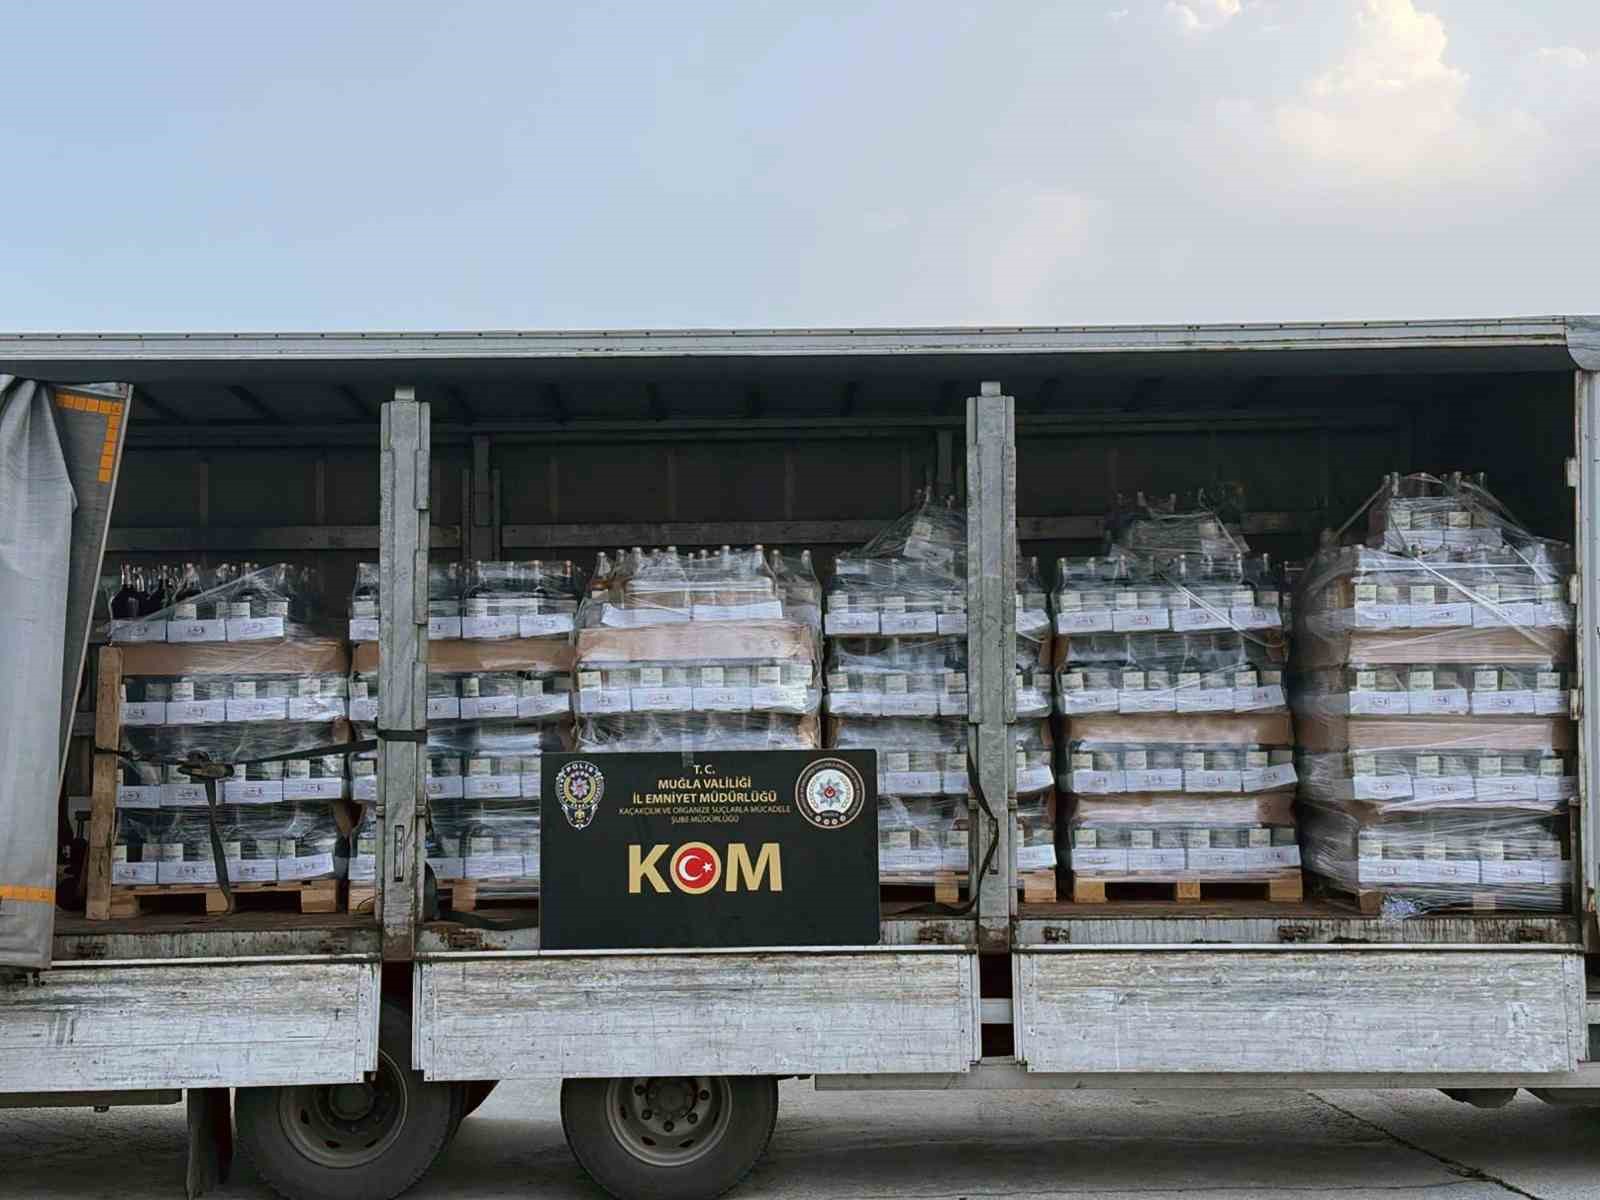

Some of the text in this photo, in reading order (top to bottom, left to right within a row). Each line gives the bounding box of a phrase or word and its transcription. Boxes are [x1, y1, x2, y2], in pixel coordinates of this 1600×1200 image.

[658, 775, 752, 789] MUĞLA VALİLİĞİ
[633, 790, 777, 804] İL EMNİYET MÜDÜRLÜĞÜ
[628, 841, 783, 895] KOM
